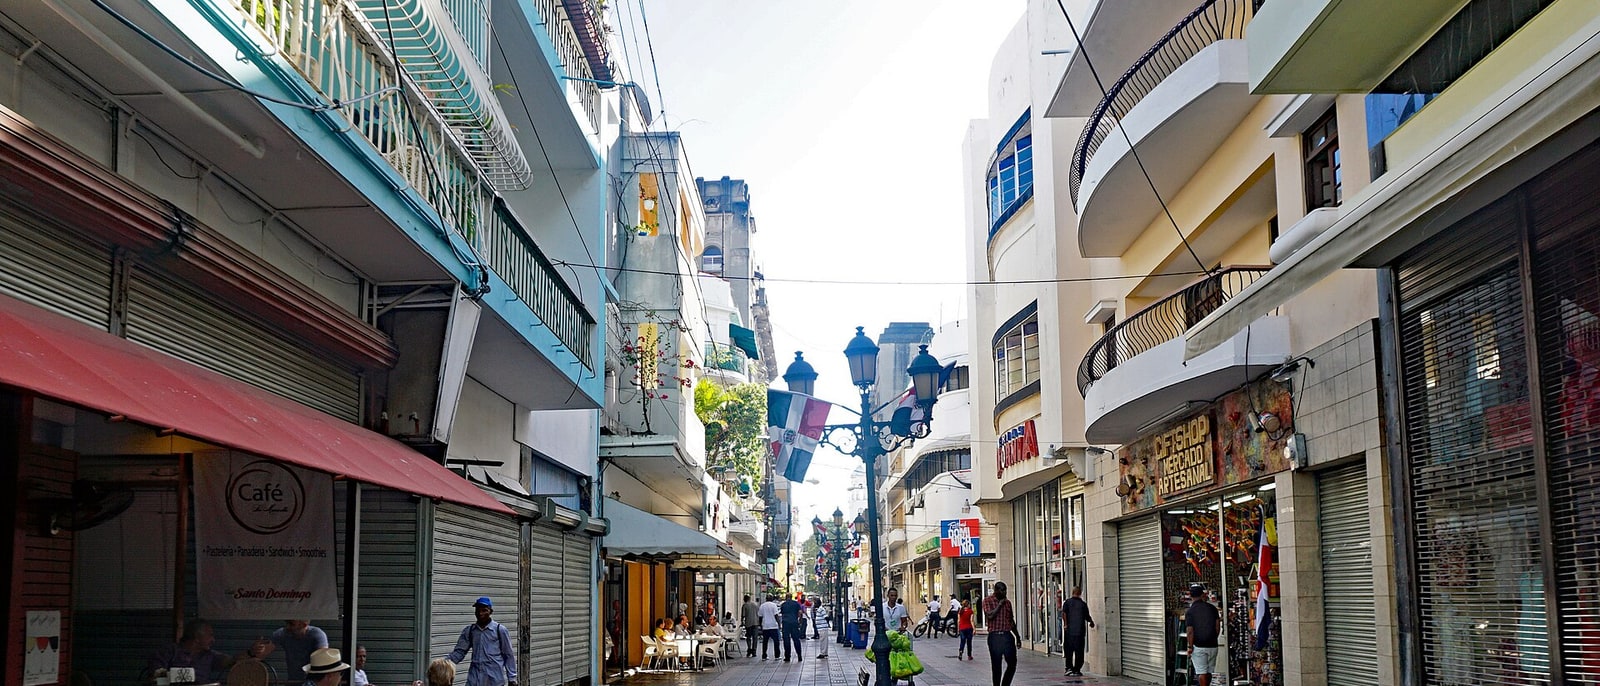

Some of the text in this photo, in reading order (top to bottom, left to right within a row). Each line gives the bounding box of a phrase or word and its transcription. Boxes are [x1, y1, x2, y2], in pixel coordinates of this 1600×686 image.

[1163, 444, 1203, 476] MERCADO
[1158, 461, 1211, 496] ARTESANAL
[238, 483, 283, 502] Café
[268, 546, 295, 558] Sandwich
[298, 546, 327, 558] Smoothies
[234, 587, 265, 599] Santo
[265, 587, 311, 603] Domingo
